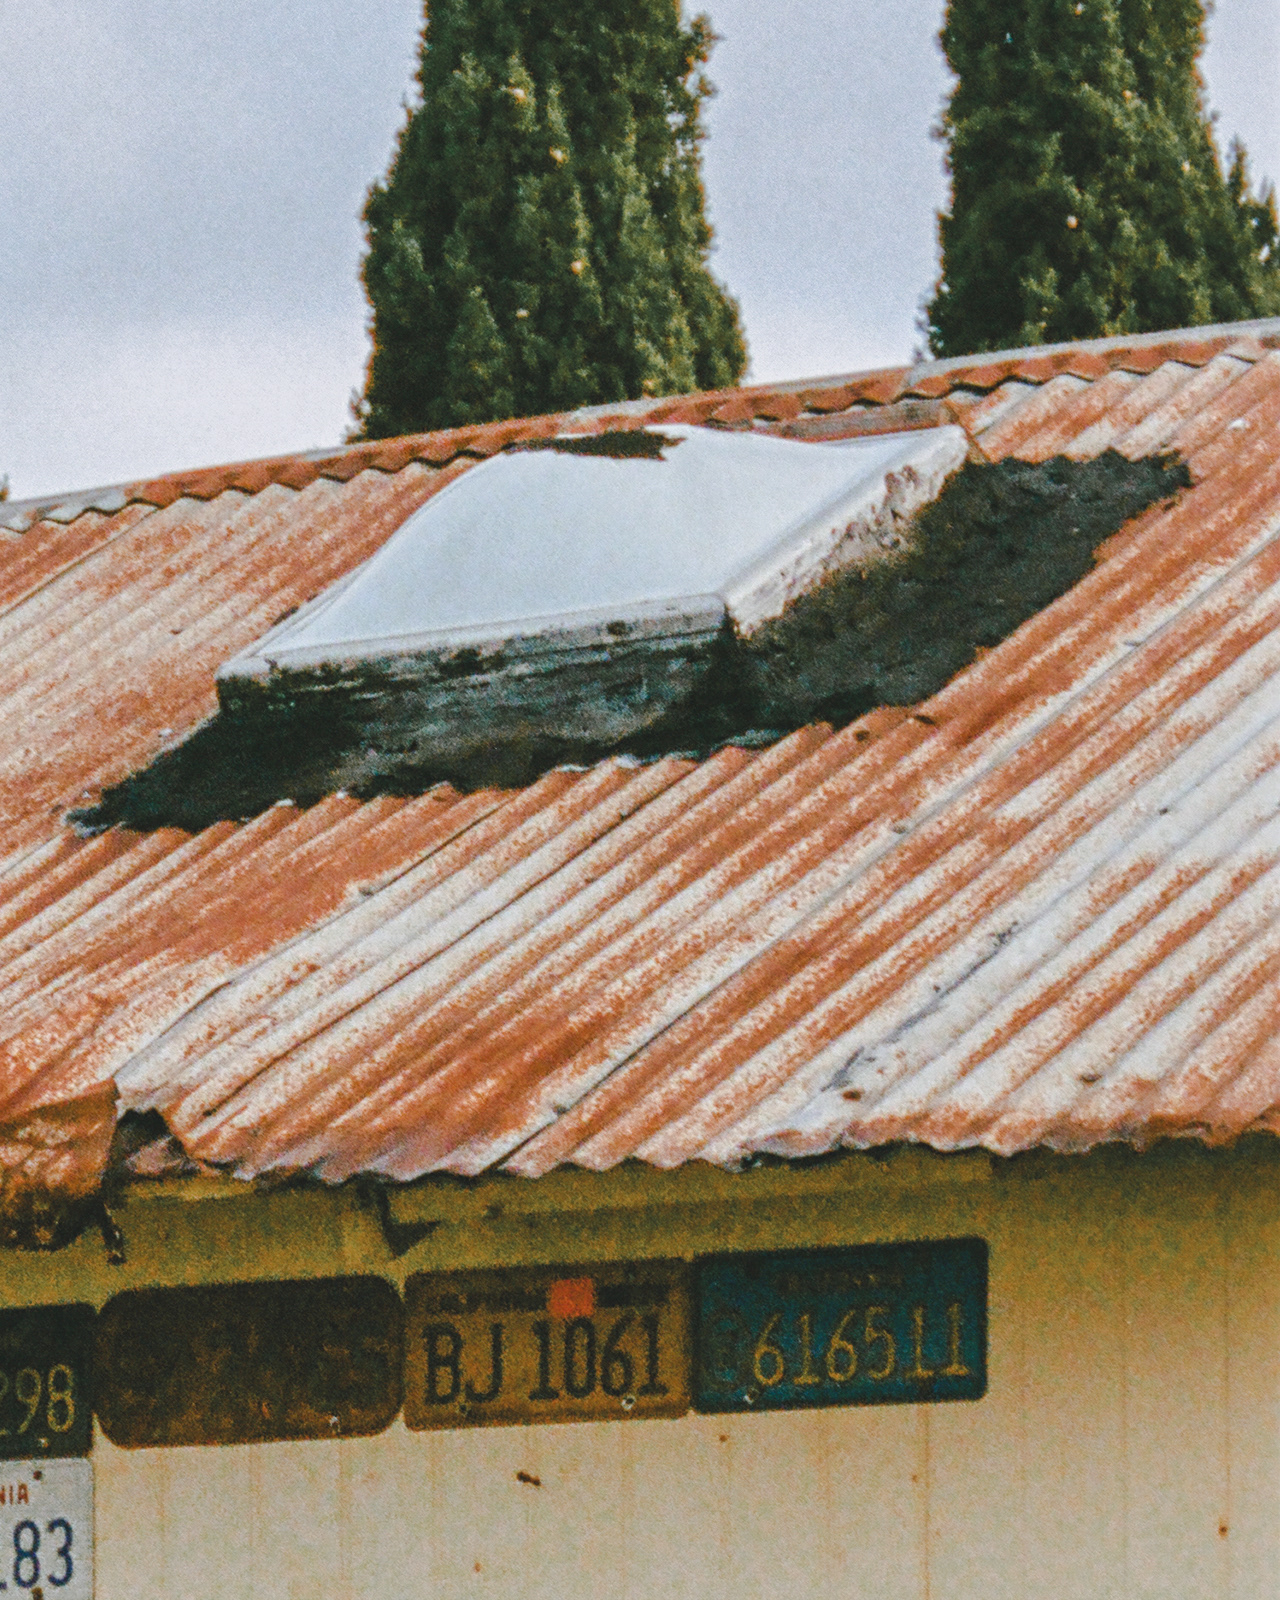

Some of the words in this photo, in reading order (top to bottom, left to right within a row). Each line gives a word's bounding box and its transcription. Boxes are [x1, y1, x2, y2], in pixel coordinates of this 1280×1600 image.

[422, 1322, 504, 1405] BJ
[530, 1314, 669, 1400] 1061
[753, 1302, 970, 1387] 616511
